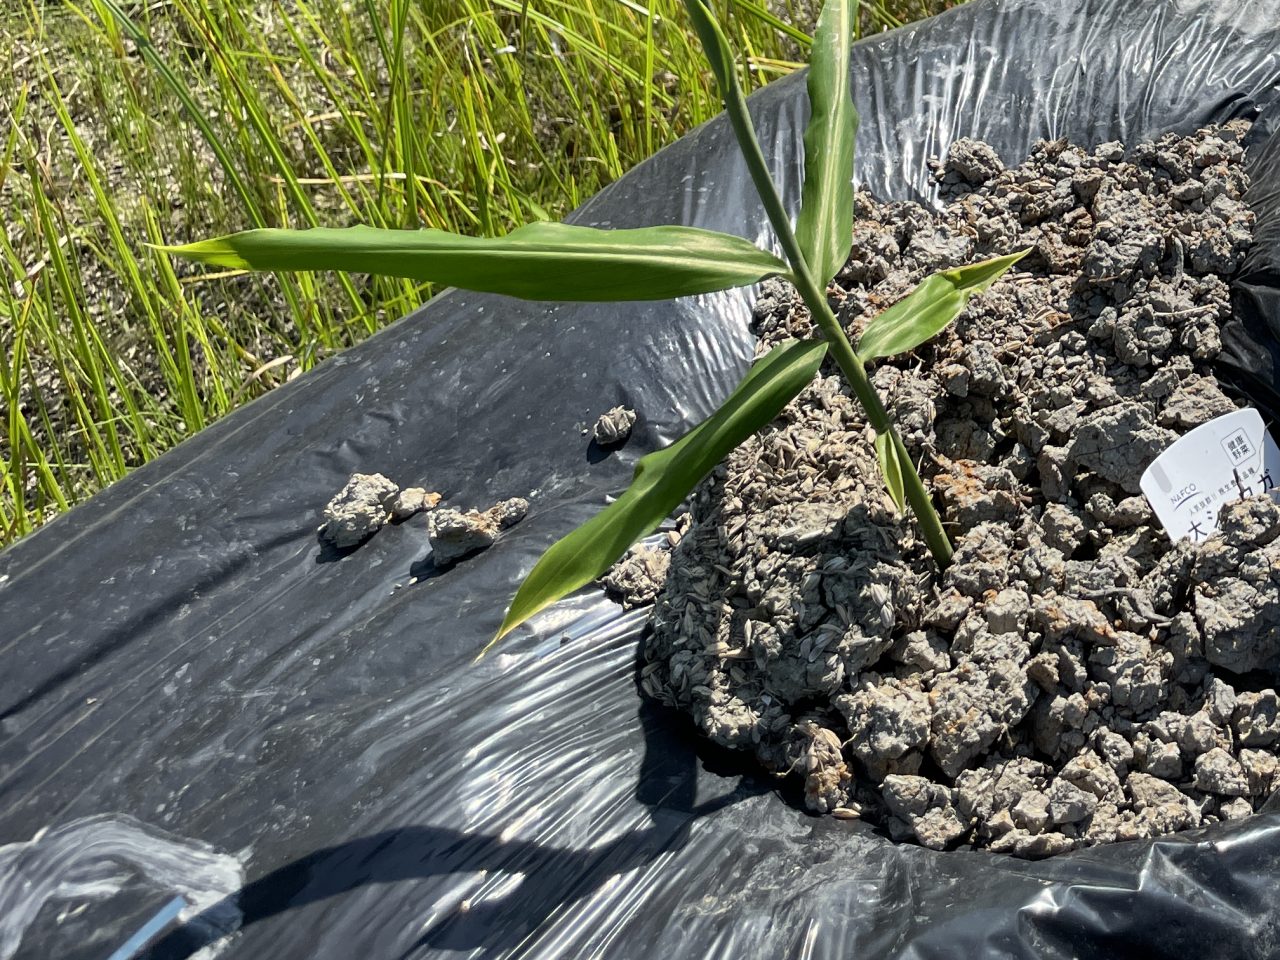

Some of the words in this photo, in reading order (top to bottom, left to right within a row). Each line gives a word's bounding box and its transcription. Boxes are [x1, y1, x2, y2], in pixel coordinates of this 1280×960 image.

[1227, 435, 1244, 451] 健康
[1232, 444, 1250, 461] 野菜
[1170, 483, 1197, 504] NAFCO
